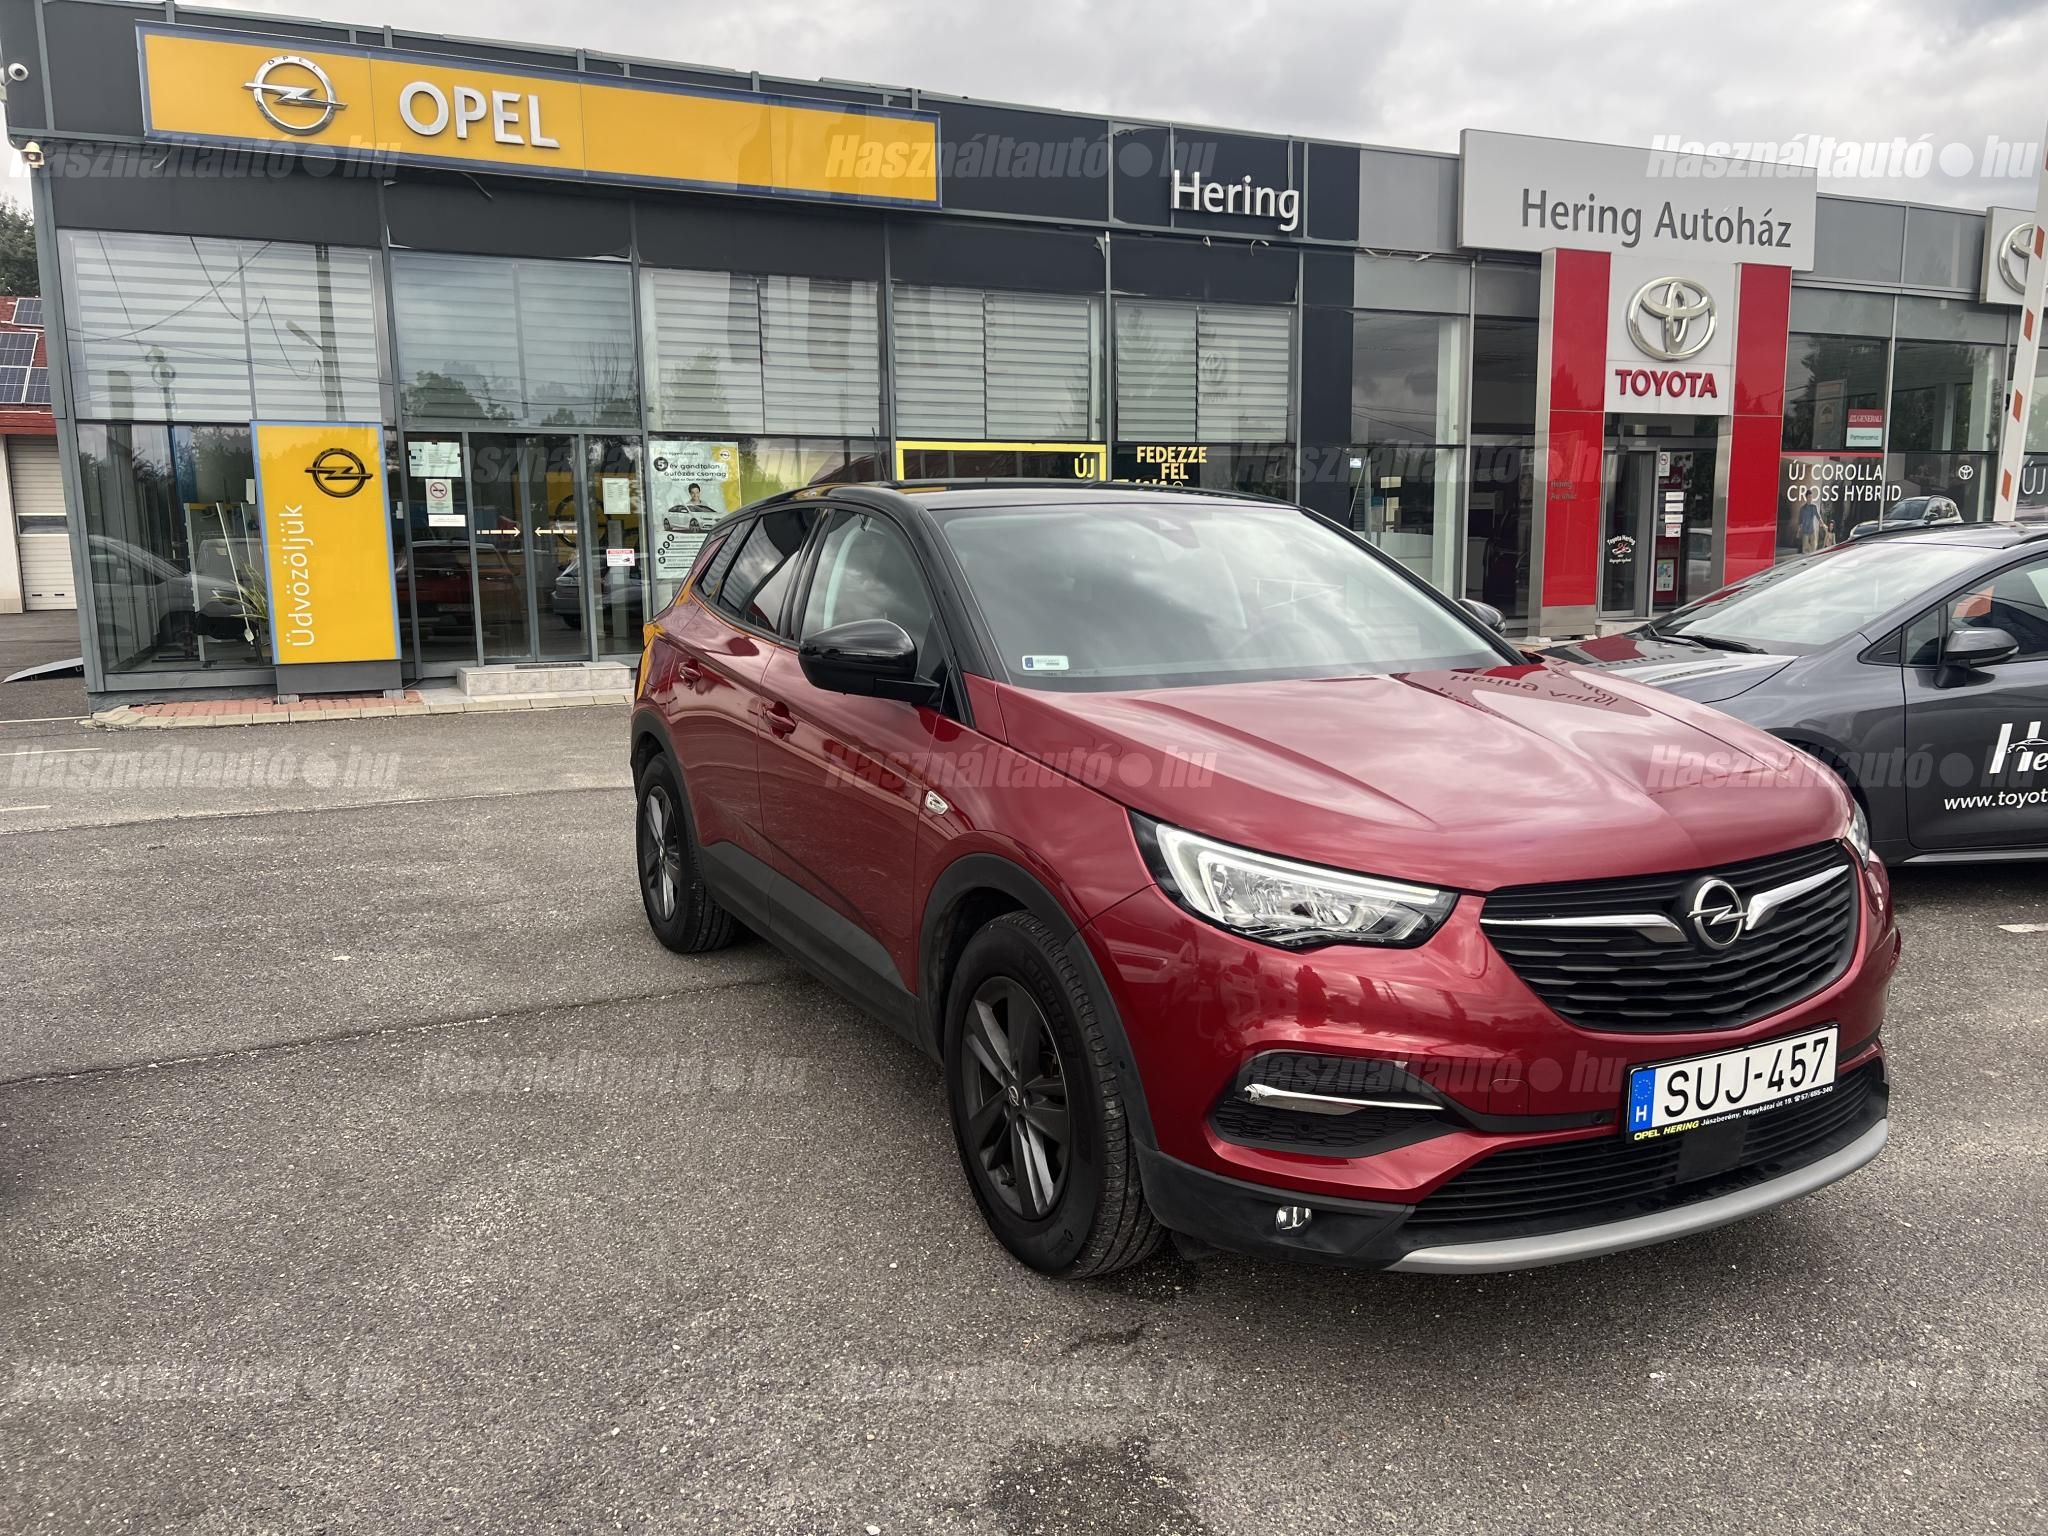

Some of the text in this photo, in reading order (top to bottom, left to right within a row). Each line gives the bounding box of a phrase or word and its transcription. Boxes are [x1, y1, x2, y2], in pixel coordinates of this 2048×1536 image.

[399, 81, 560, 149] OPEL
[1172, 169, 1299, 231] Hering
[1521, 188, 1792, 248] Hering Autóház
[1615, 368, 1718, 398] TOYOTA
[1074, 453, 1095, 478] ÚJ
[1136, 446, 1208, 463] FEDEZZE
[1161, 463, 1189, 480] FEL
[1788, 459, 1883, 481] ÚJ COROLLA
[2022, 460, 2047, 495] ÚJ
[1786, 485, 1902, 501] CROSS HYBRID
[279, 504, 314, 647] Üdvözöljük
[1664, 1036, 1829, 1118] SUJ-457
[1635, 1105, 1647, 1123] H
[1634, 1129, 1660, 1141] OPEL
[1663, 1120, 1699, 1136] HERING
